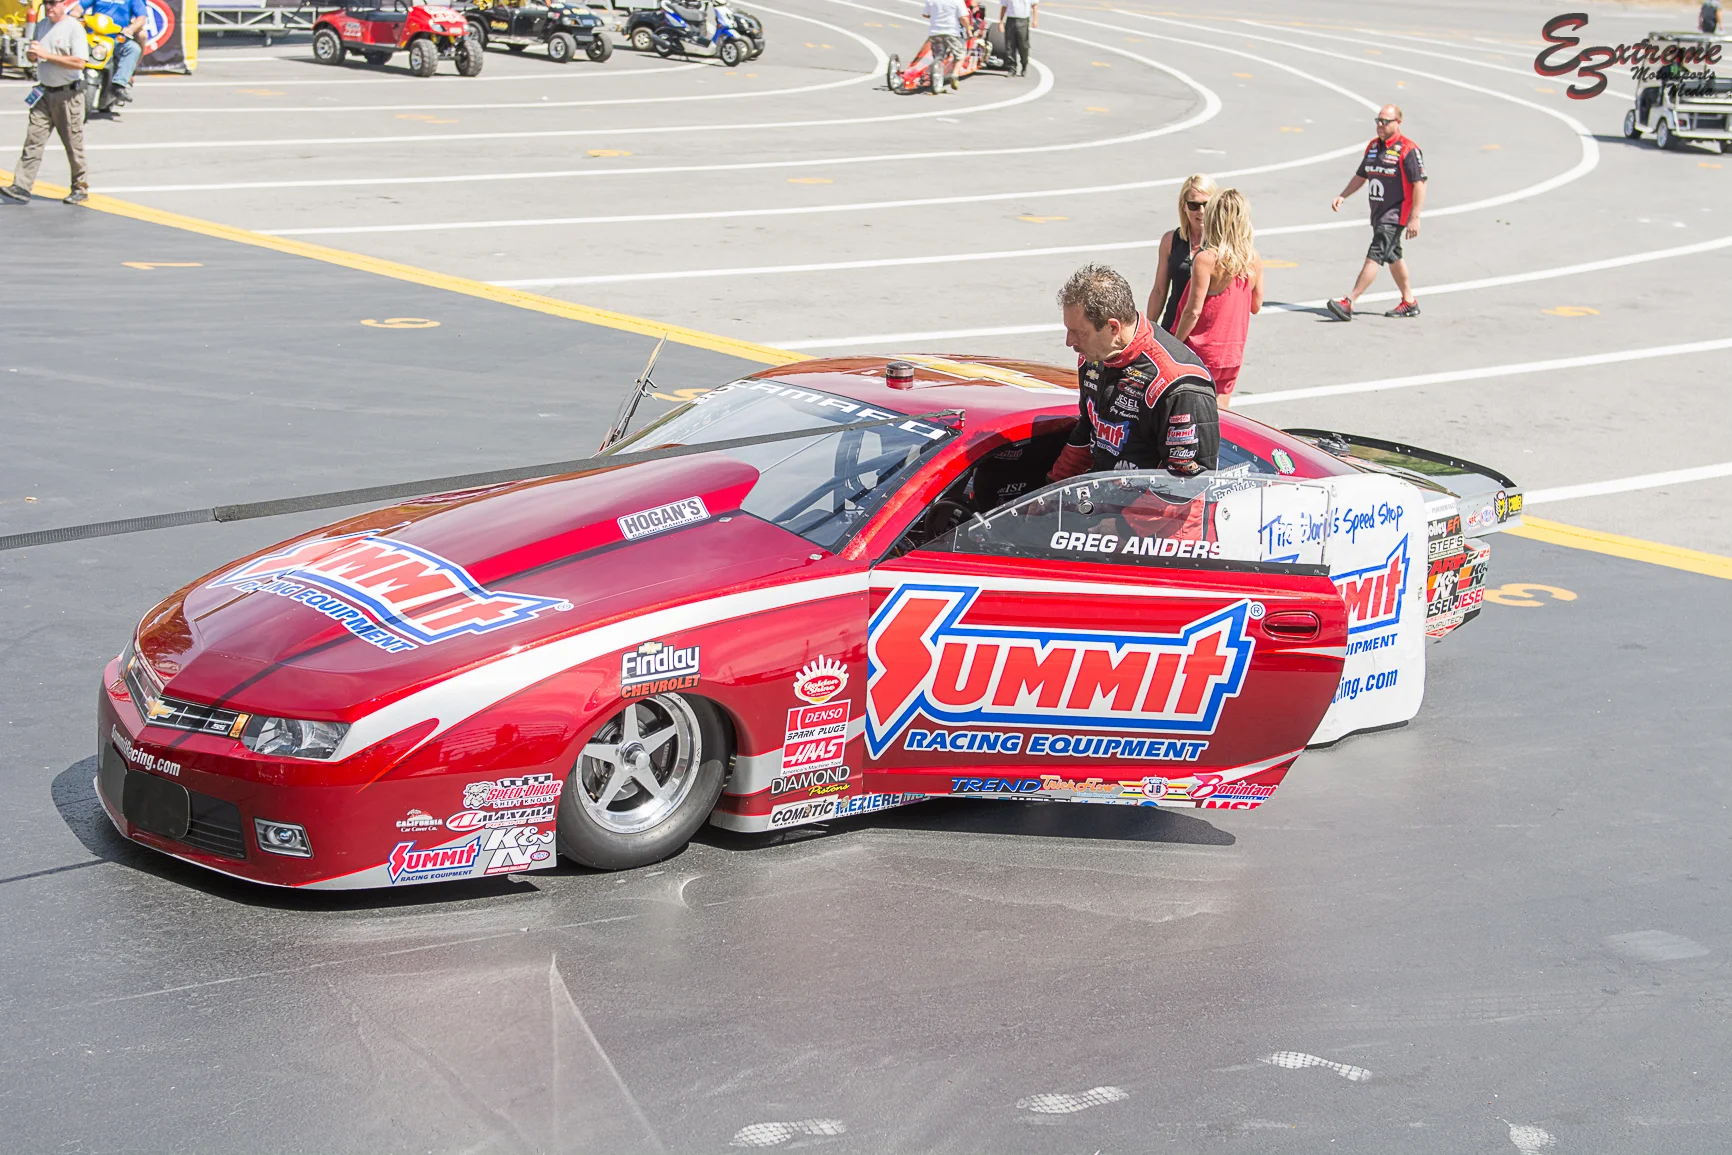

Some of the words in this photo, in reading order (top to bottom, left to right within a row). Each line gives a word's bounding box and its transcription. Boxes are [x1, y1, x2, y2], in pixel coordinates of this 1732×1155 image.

[623, 500, 701, 534] HOGAN'S
[1343, 504, 1375, 545] Speed
[1378, 500, 1404, 532] Shop
[1428, 521, 1447, 538] olley
[1051, 531, 1119, 554] GREG
[1121, 536, 1224, 560] ANDERS
[1429, 536, 1463, 554] STEF'S
[1430, 553, 1467, 576] ARP
[294, 587, 417, 653] EQUIPMENT
[1427, 599, 1454, 618] ESEL
[621, 645, 701, 680] Findlay
[621, 674, 701, 698] CHEVROLET
[804, 679, 839, 691] Golden
[807, 685, 836, 695] Shine
[804, 708, 843, 723] DENSO
[787, 730, 816, 741] SPARK
[817, 724, 846, 735] PLUGS
[112, 724, 182, 777] SummitRacing.com
[785, 742, 838, 766] HAAS
[906, 731, 1021, 755] RACING
[1030, 735, 1208, 761] EQUIPMENT
[487, 785, 524, 801] SPEED
[525, 781, 562, 797] DAWG
[771, 767, 851, 794] DIAMOND
[808, 783, 850, 797] Pistons
[951, 779, 1042, 793] TREND
[1190, 772, 1279, 799] Boninfant
[494, 800, 520, 808] SHIFT
[525, 796, 554, 804] KNOBS
[396, 819, 443, 828] CALIFORNIA
[484, 827, 555, 870] K&N
[389, 844, 478, 880] SUMMIT
[401, 874, 429, 882] RACING
[431, 869, 473, 879] EQUIPMENT
